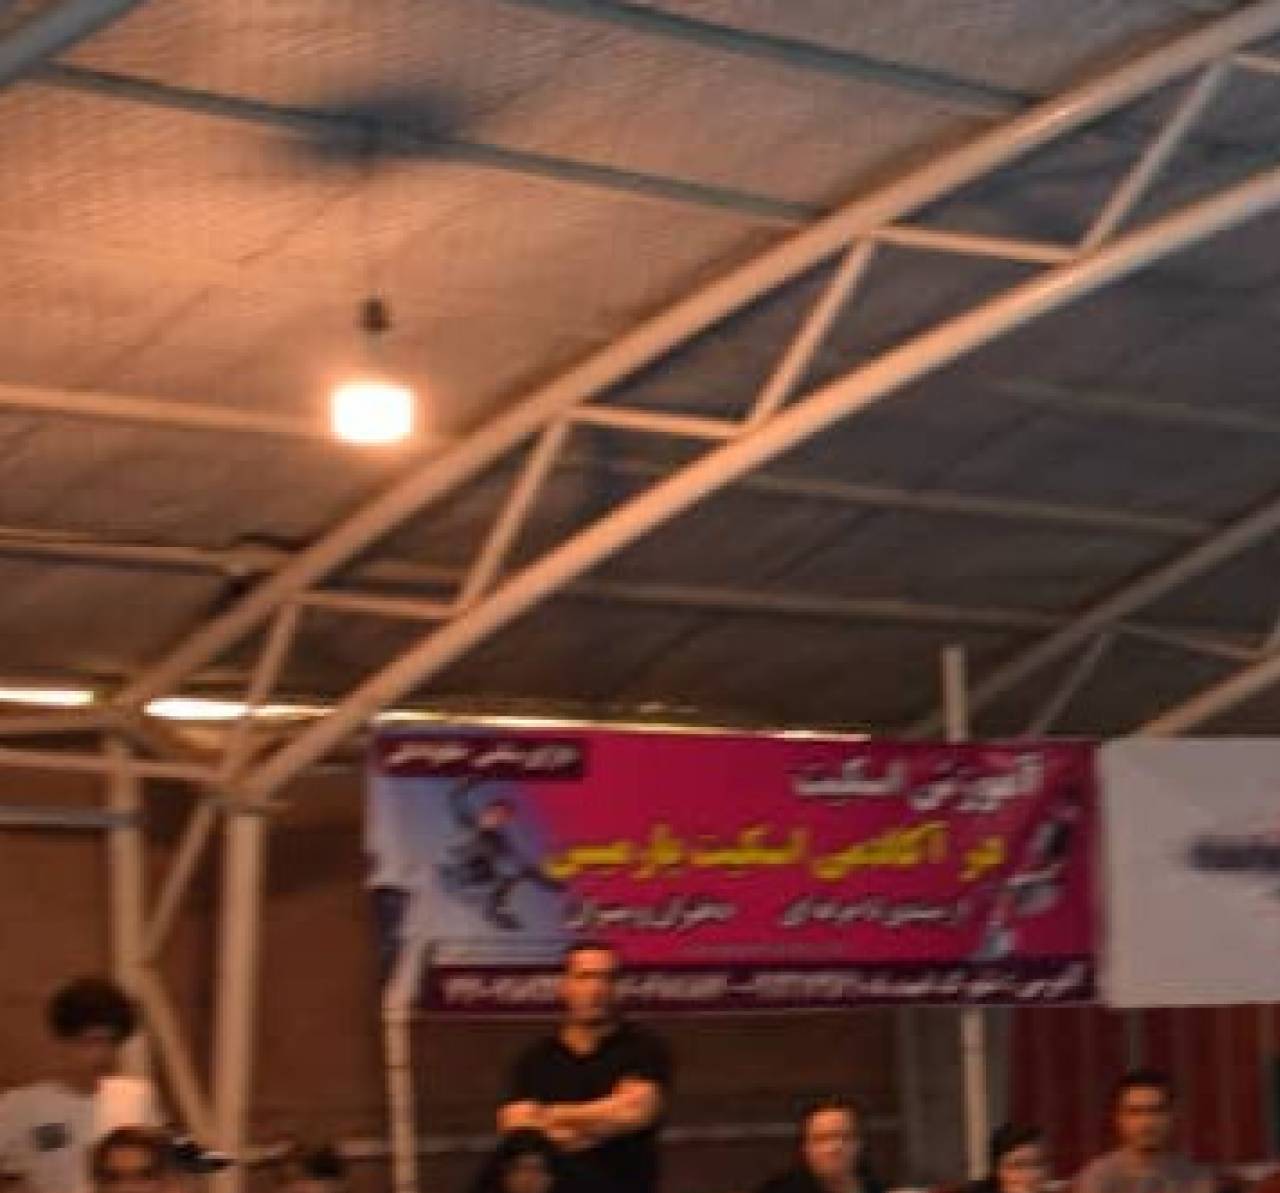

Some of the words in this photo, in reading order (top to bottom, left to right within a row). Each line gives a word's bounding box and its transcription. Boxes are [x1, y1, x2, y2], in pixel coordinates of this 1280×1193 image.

[793, 757, 907, 807] اسکیت
[690, 823, 808, 880] اسکیت
[958, 835, 1006, 882] در
